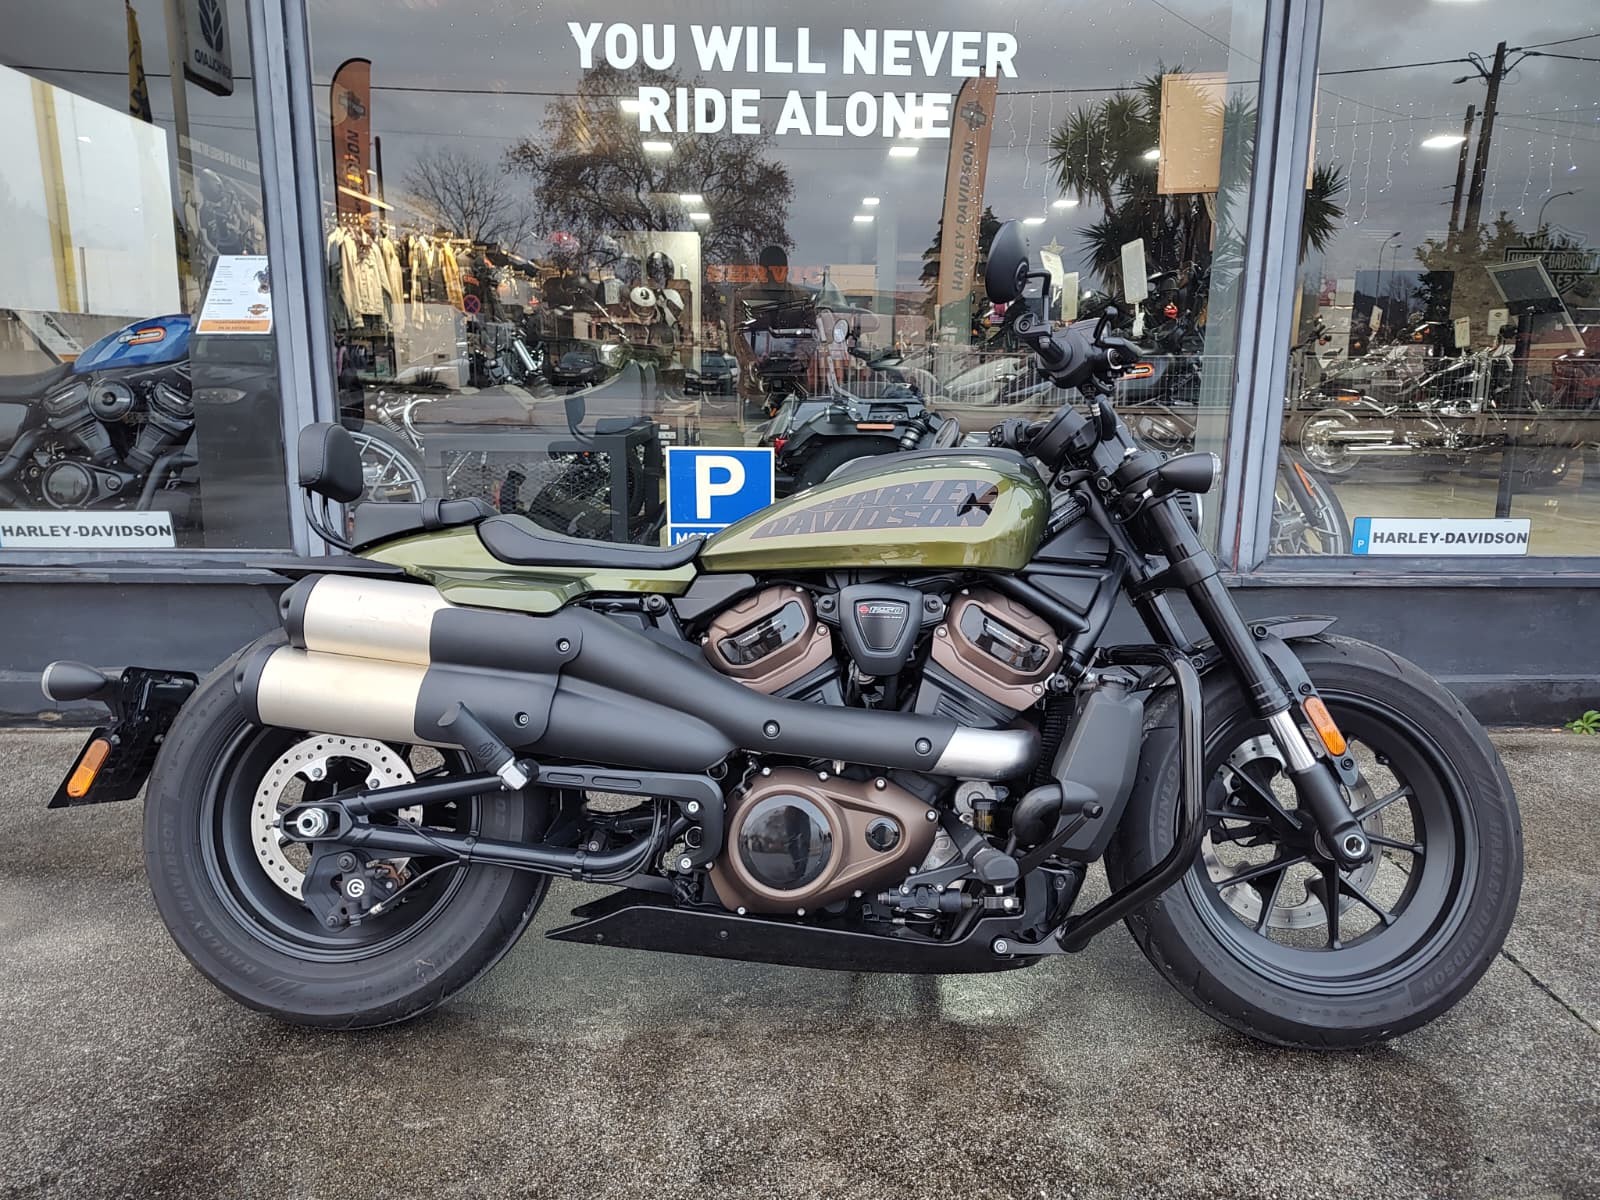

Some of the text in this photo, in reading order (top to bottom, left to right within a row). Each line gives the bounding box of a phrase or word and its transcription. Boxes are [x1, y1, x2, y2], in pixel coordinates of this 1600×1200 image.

[567, 21, 1019, 79] YOU WILL NEVER
[638, 86, 952, 139] RIDE ALONE
[952, 141, 975, 291] HARLEY-DAVIDSON
[696, 455, 745, 519] P
[1, 525, 172, 537] HARLEY-DAVIDSON
[1357, 539, 1365, 549] P
[1373, 531, 1527, 544] HARLEY-DAVIDSON
[1423, 820, 1505, 994] HARLEY-DAVIDSON
